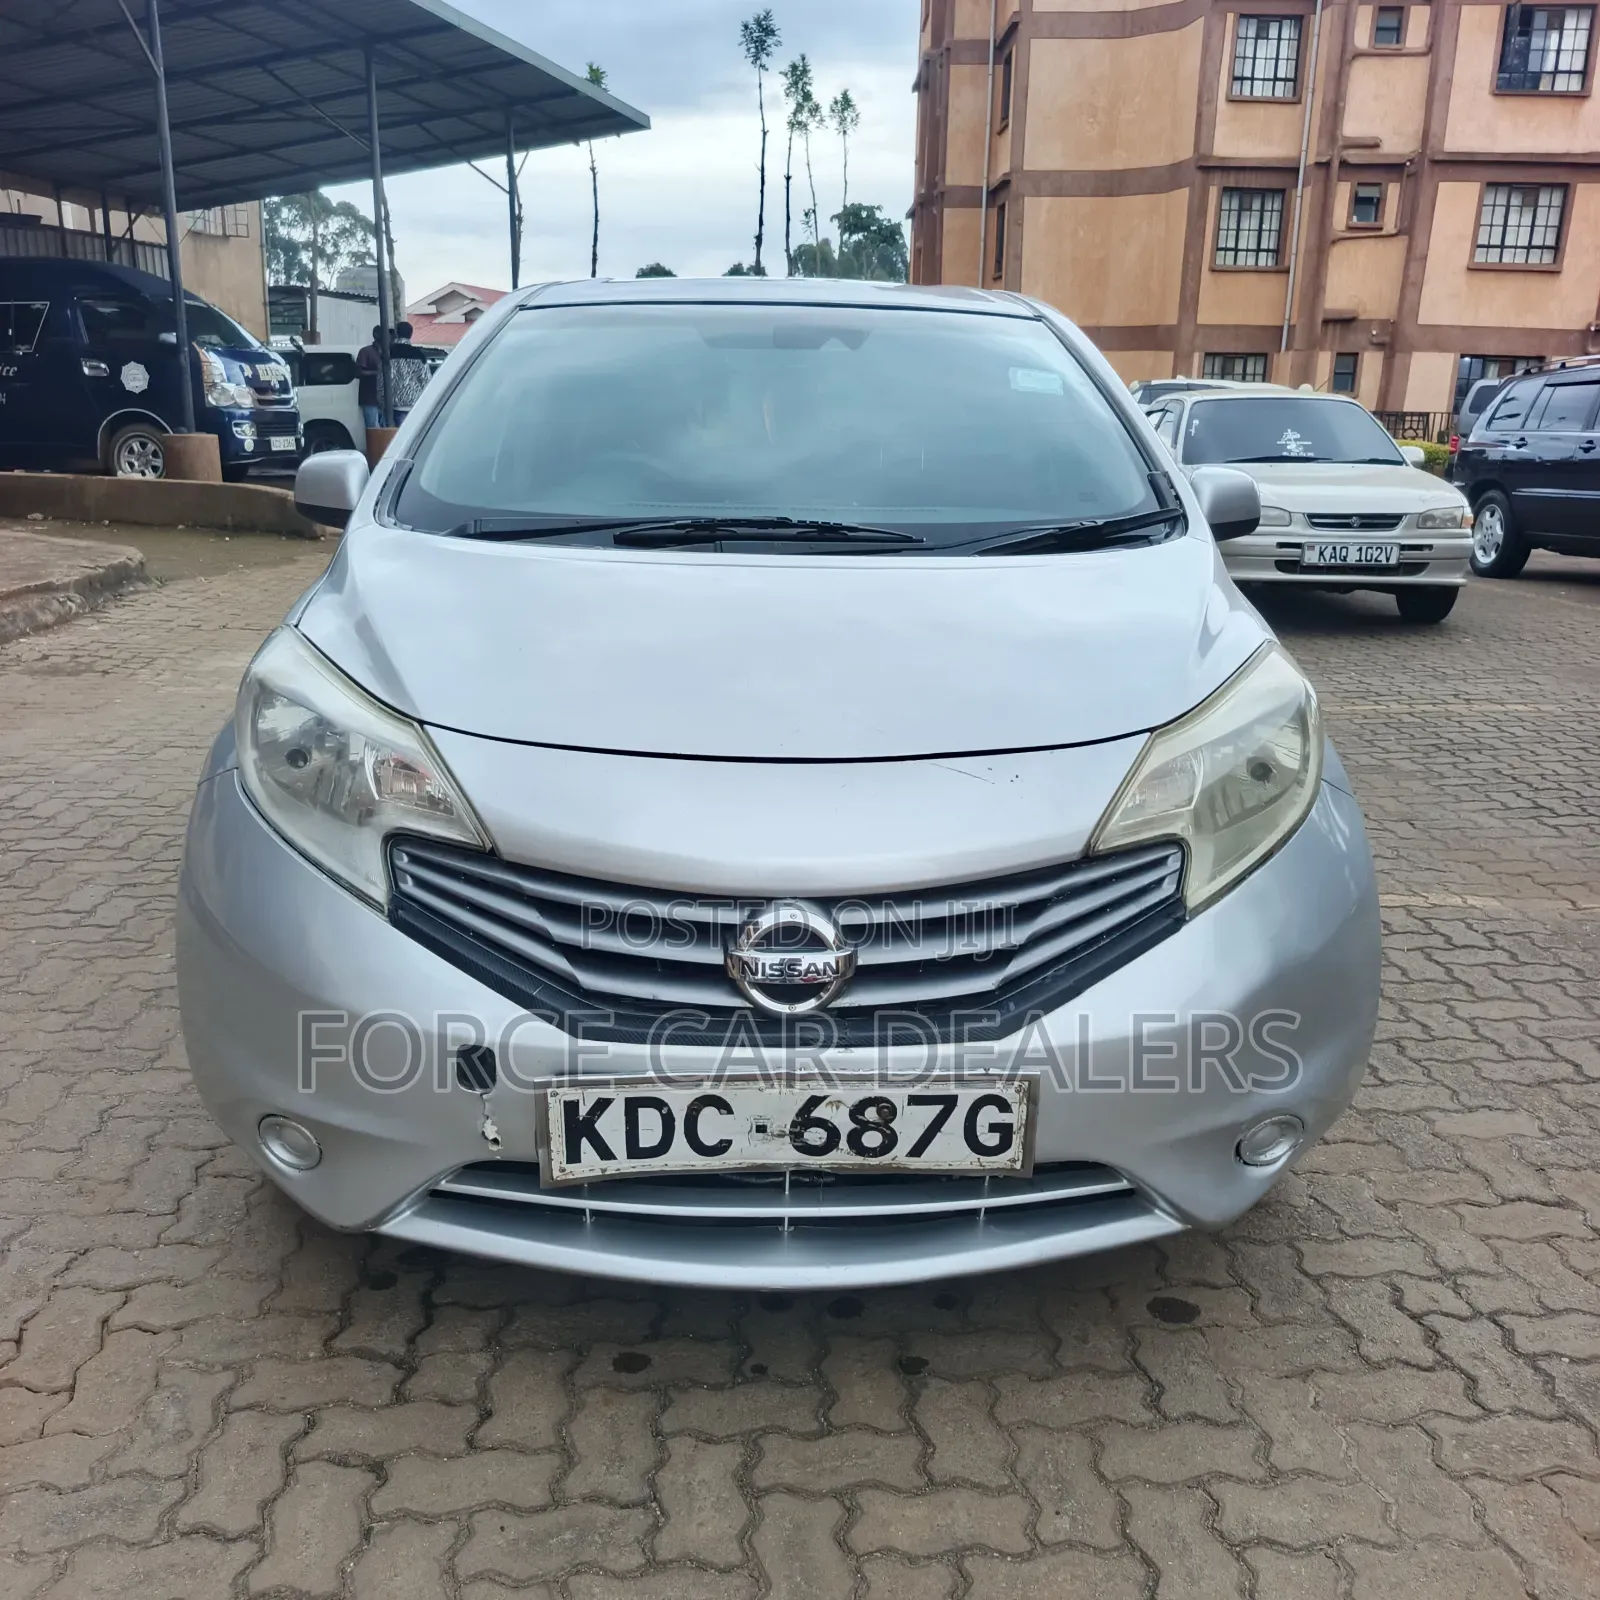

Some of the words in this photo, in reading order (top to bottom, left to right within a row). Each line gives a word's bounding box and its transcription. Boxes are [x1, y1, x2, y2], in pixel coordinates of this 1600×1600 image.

[1318, 545, 1349, 563] KAQ
[1354, 546, 1394, 563] 102V
[740, 958, 840, 979] NISSAN
[563, 1095, 735, 1164] KDC
[789, 1094, 1015, 1158] 687G
